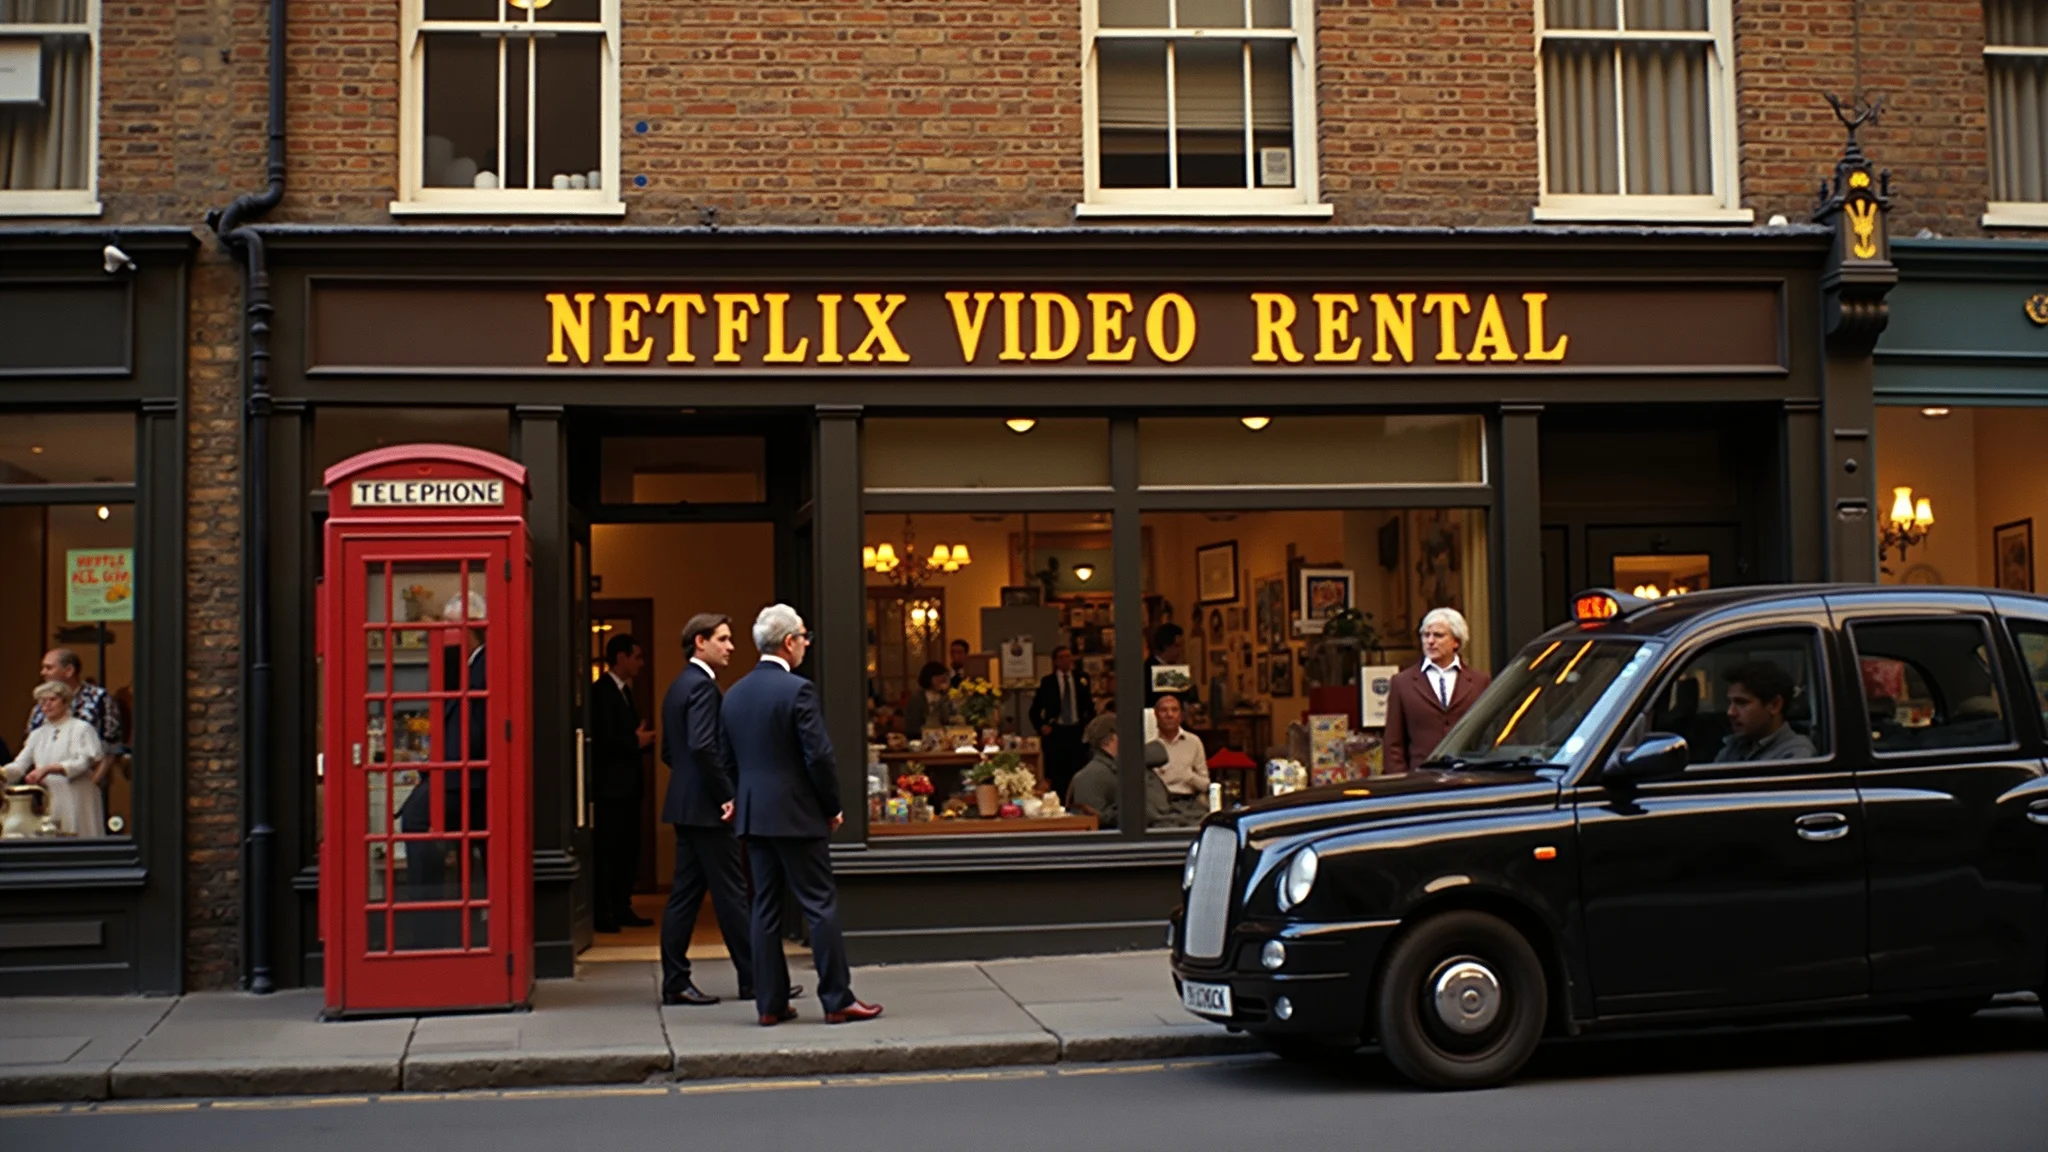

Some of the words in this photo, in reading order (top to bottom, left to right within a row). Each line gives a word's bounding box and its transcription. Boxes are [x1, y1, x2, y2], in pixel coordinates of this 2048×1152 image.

[545, 293, 911, 364] NETFLIX
[944, 292, 1196, 363] VIDEO
[1250, 293, 1568, 363] RENTAL
[358, 483, 500, 502] TELEPHONE
